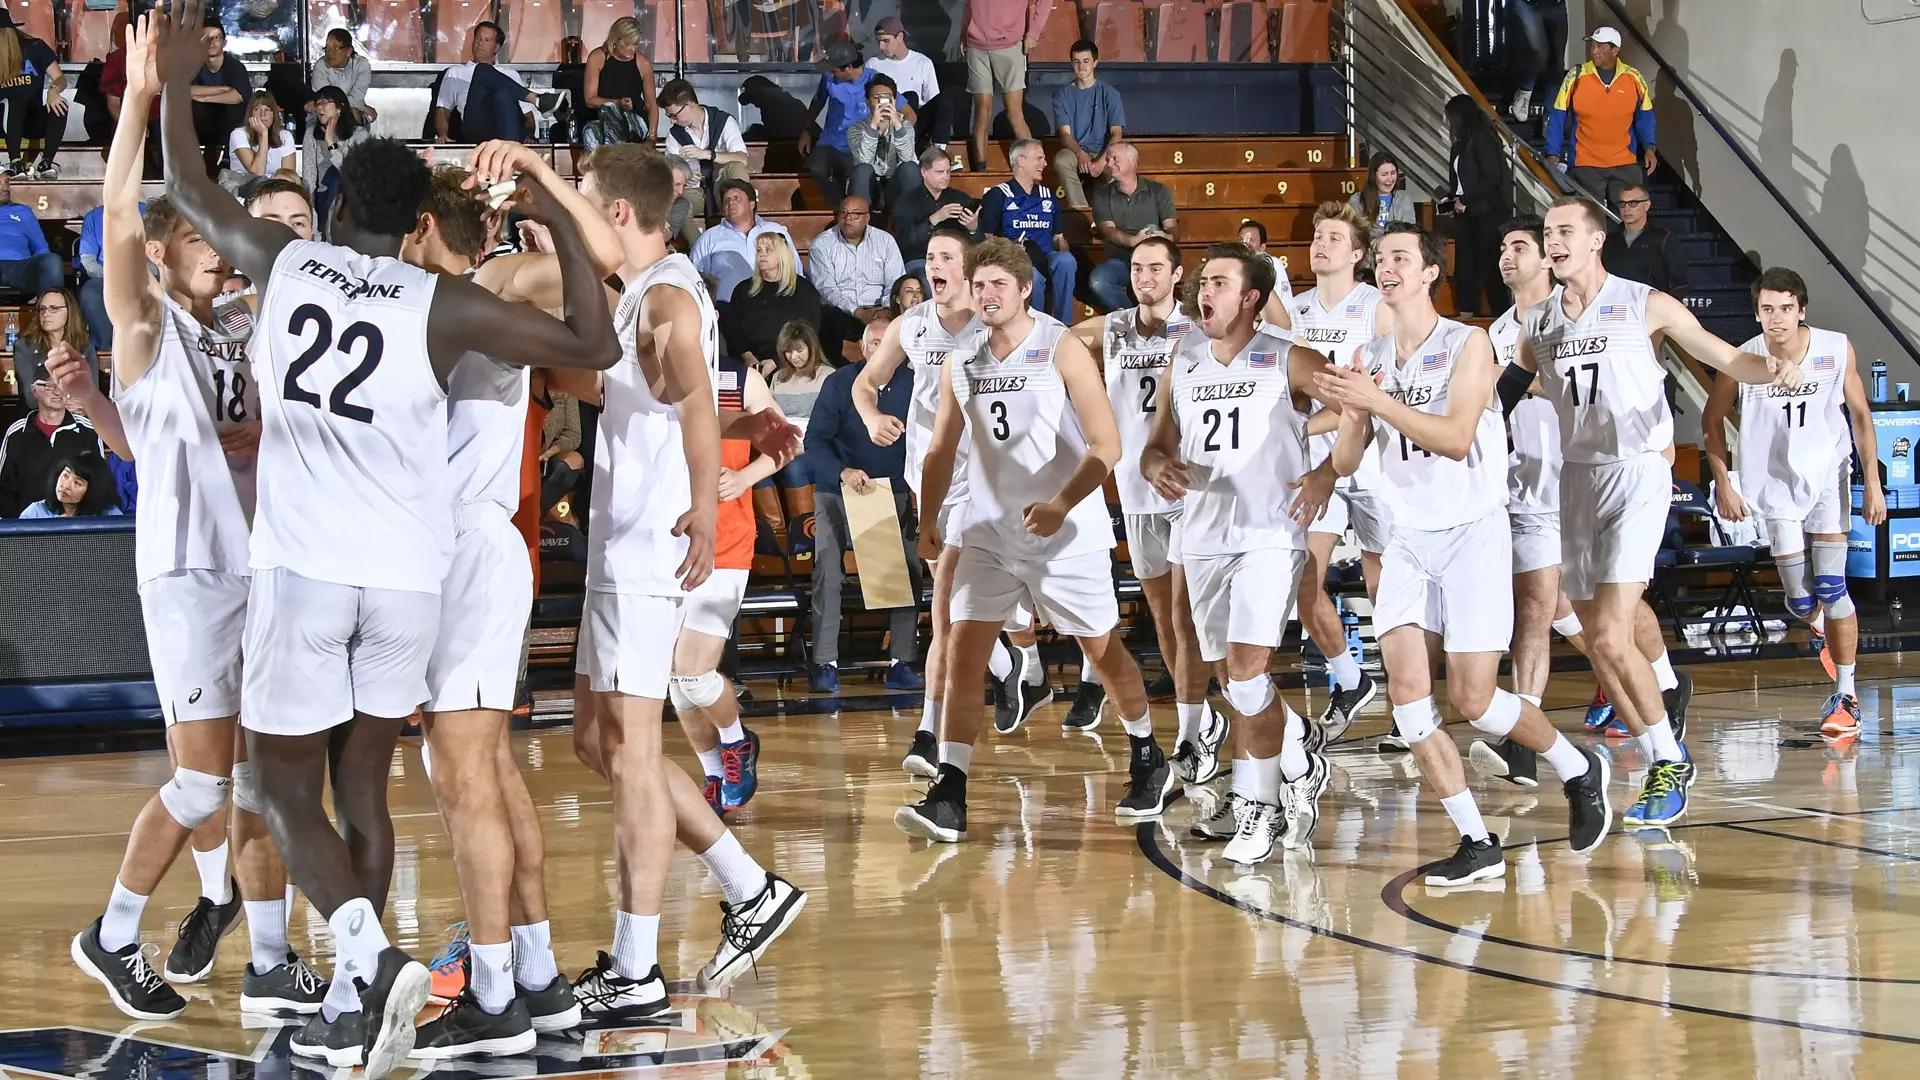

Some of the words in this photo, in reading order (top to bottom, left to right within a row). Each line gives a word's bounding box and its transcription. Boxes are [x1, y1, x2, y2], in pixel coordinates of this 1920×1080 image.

[1, 75, 32, 88] UINS
[1174, 151, 1183, 164] 8
[1245, 150, 1255, 163] 9
[1307, 149, 1322, 163] 10
[1056, 185, 1066, 198] 6
[1206, 182, 1215, 196] 8
[1278, 181, 1288, 194] 9
[1341, 181, 1355, 194] 10
[38, 195, 49, 210] 5
[1012, 219, 1050, 229] Emirates
[1026, 213, 1039, 221] Fly
[1682, 297, 1712, 308] STEP
[1084, 305, 1094, 317] 5
[1303, 328, 1347, 343] WAVES
[198, 337, 247, 362] WAVE
[1550, 336, 1608, 361] WAVES
[283, 303, 385, 425] 22
[1120, 353, 1172, 370] WAVES
[3, 369, 17, 385] 4
[1564, 362, 1599, 407] 17
[973, 376, 1027, 396] WAVES
[1192, 381, 1257, 402] WAVES
[213, 369, 247, 423] 18
[1140, 375, 1157, 413] 2
[990, 400, 1010, 441] 3
[1782, 401, 1806, 429] 11
[1203, 406, 1239, 453] 21
[1671, 493, 1693, 502] AVES
[557, 501, 570, 517] 9
